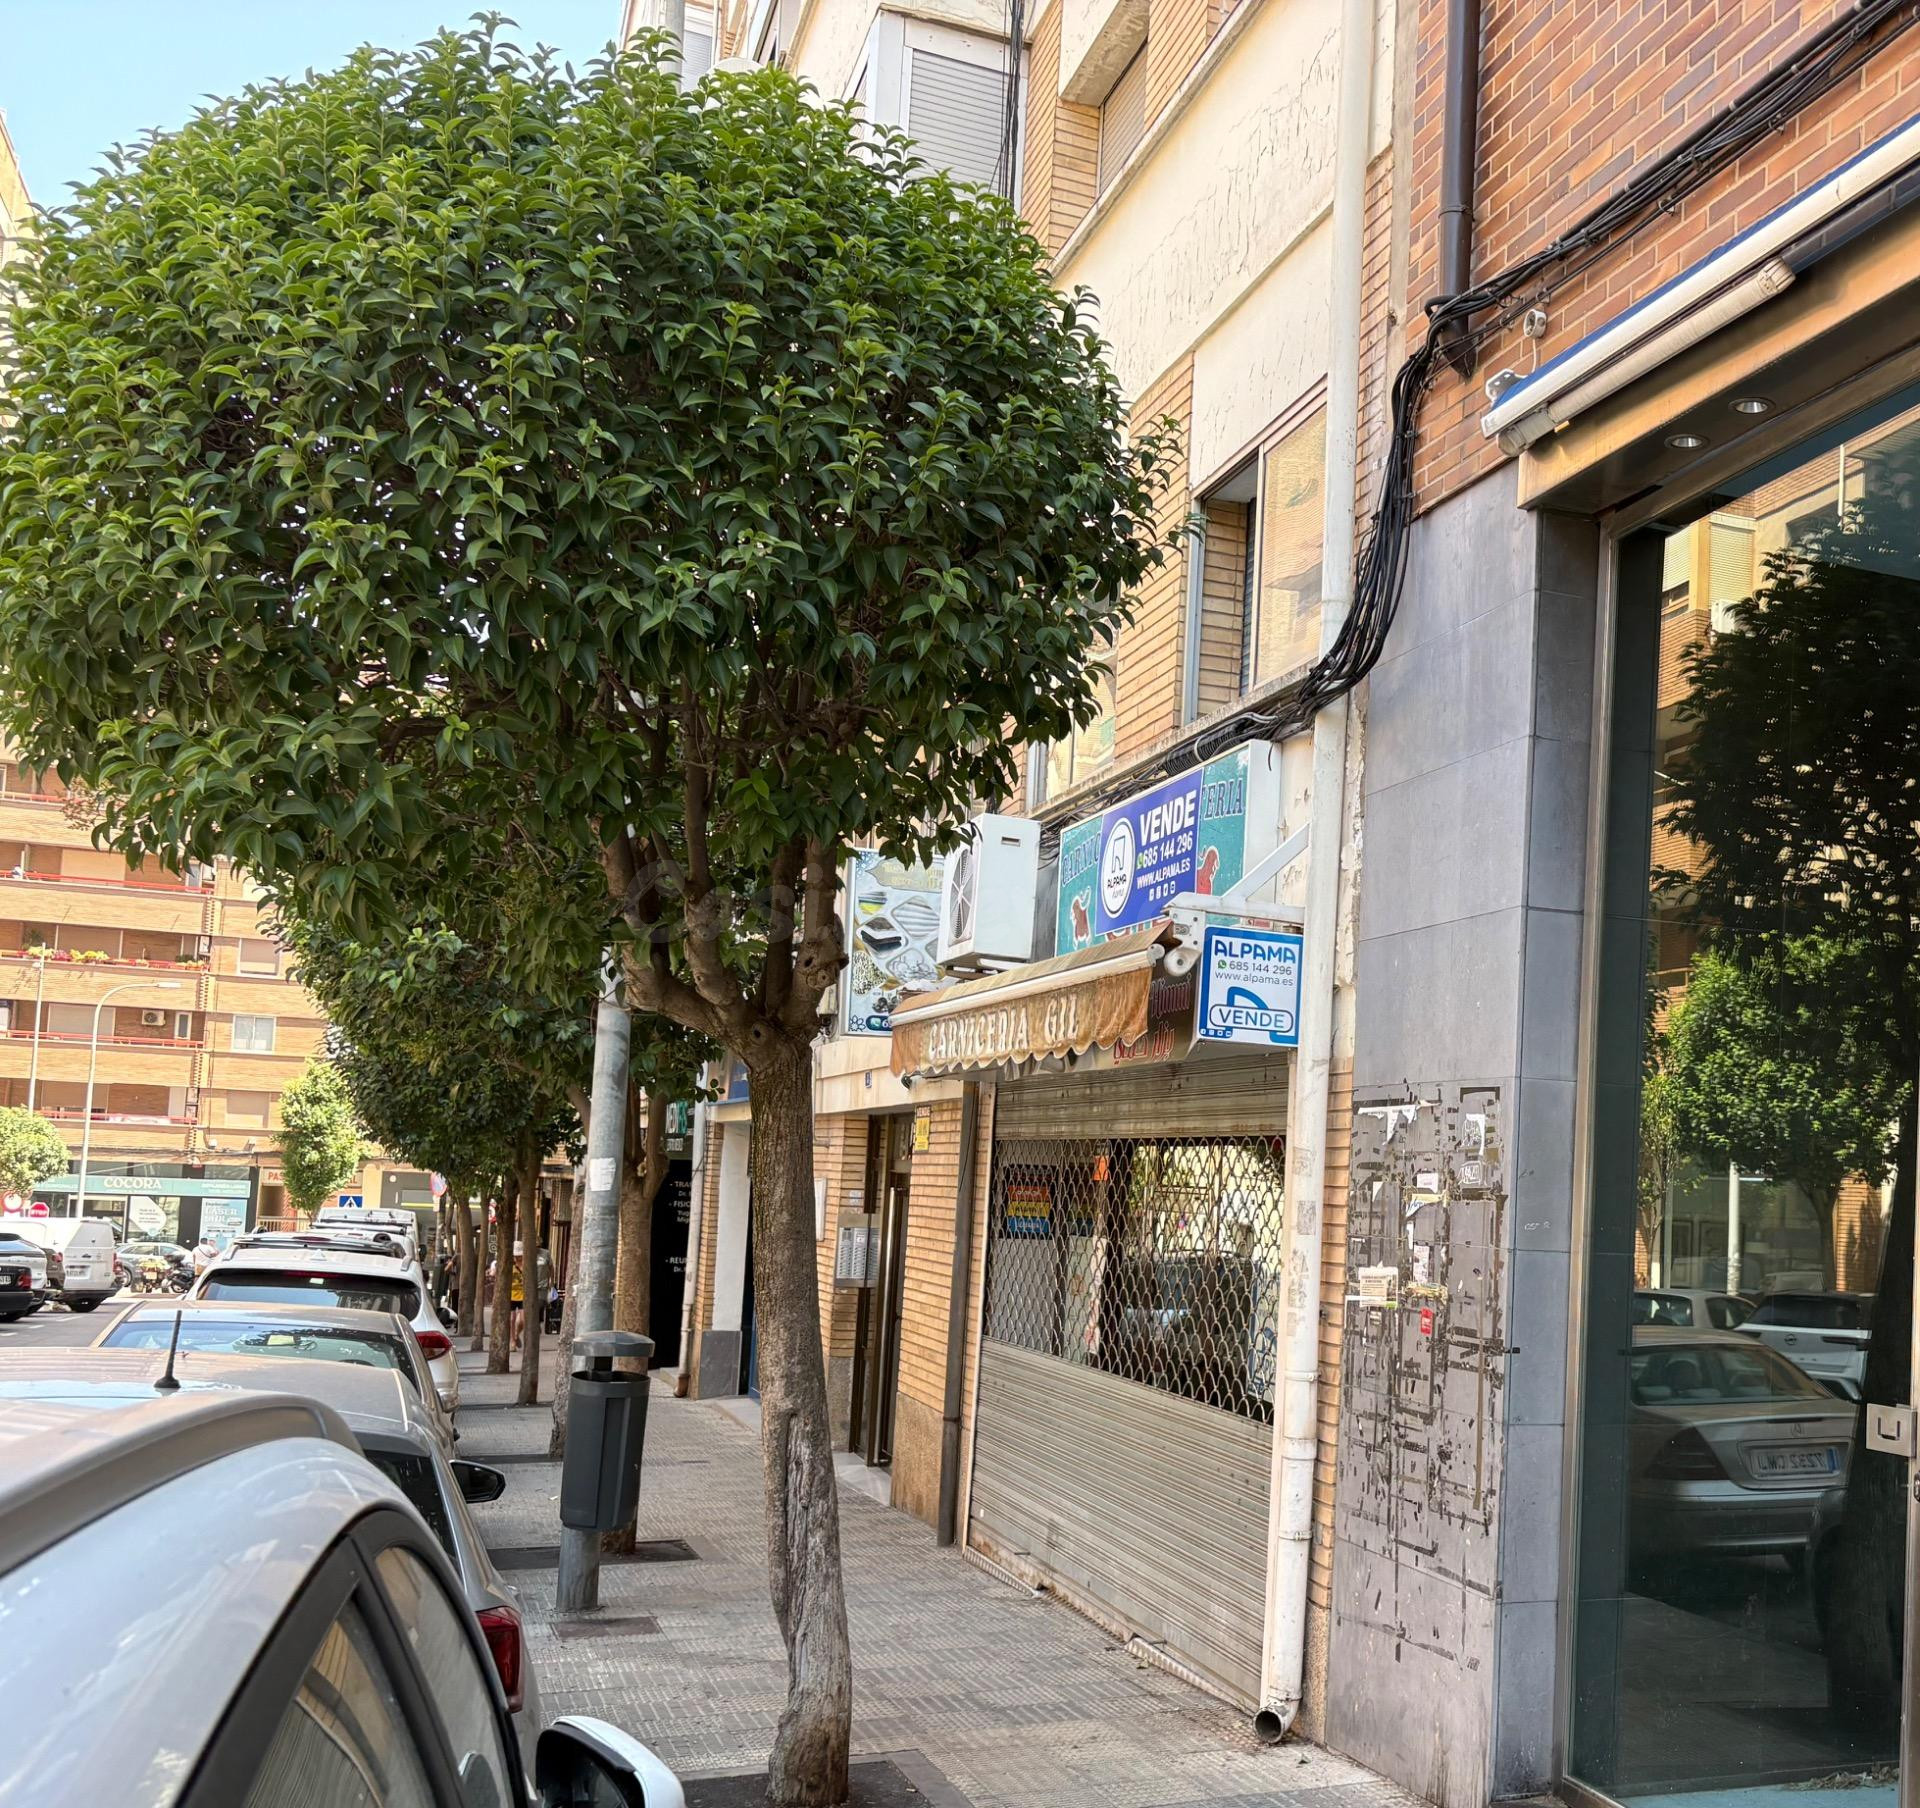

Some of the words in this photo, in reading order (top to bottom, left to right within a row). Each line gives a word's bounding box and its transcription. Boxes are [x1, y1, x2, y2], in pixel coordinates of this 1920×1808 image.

[1140, 790, 1197, 846] VENDE
[1143, 845, 1158, 869] 685
[1160, 838, 1175, 861] 144
[1176, 831, 1193, 855] 296
[1107, 874, 1127, 889] ALPAMA
[1137, 858, 1191, 890] WWW.ALPAMA.ES
[1214, 940, 1296, 964] ALPAMA
[1229, 960, 1248, 971] 685
[1252, 963, 1269, 973] 144
[1272, 965, 1292, 975] 296
[1215, 971, 1294, 986] www.alpama.es
[928, 1006, 1030, 1061] CARNICERIA
[1044, 994, 1079, 1043] GIL
[1218, 1008, 1285, 1029] VENDE
[104, 1177, 161, 1189] COCORA
[30, 1209, 48, 1217] STOP
